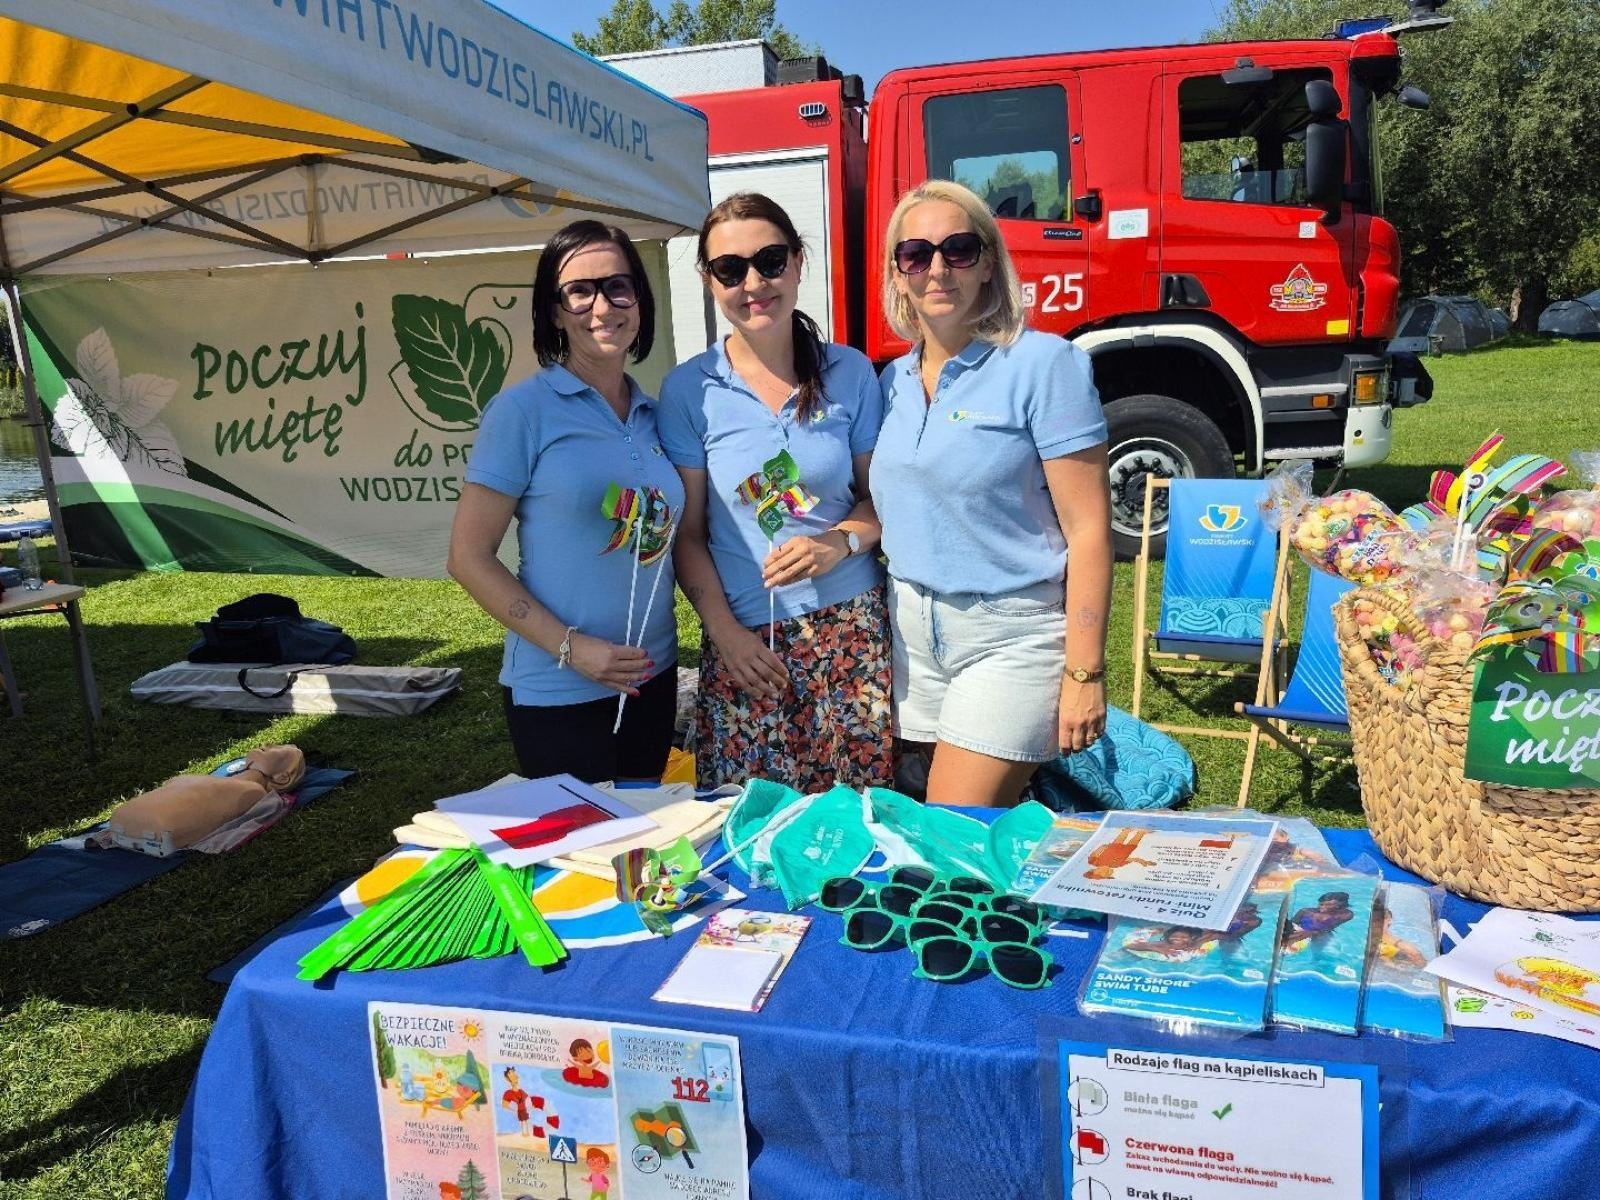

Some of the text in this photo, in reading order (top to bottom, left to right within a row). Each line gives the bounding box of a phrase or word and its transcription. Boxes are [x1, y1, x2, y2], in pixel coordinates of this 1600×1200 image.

[272, 0, 654, 162] IATWODZISLAWSKI.PL
[1041, 272, 1083, 313] 25
[191, 302, 367, 406] Poczuj
[215, 396, 343, 463] miętę
[394, 429, 433, 467] do
[340, 476, 464, 501] WODZIS
[1056, 884, 1125, 900] ratownika
[1171, 907, 1206, 919] Quiz
[1095, 981, 1168, 994] SWIM TUBE
[1096, 973, 1192, 987] SANDY SHORE
[380, 1015, 455, 1033] BEZPIECZNE
[386, 1033, 447, 1049] WAKACJE!
[1113, 1053, 1318, 1081] Rodzaje flag na kąpieliskach
[671, 1076, 711, 1102] 112
[1124, 1091, 1198, 1110] Biała flaga
[1125, 1137, 1234, 1162] Czerwona flaga
[1125, 1152, 1150, 1161] Zakaz
[1152, 1156, 1203, 1169] wchodzenia
[1204, 1161, 1215, 1169] do
[1217, 1164, 1242, 1174] wody.
[1244, 1167, 1260, 1175] Nie
[1261, 1168, 1288, 1178] wolno
[1289, 1171, 1303, 1182] się
[1126, 1163, 1151, 1172] nawet
[1165, 1167, 1195, 1179] własną
[1197, 1172, 1278, 1188] odpowiedzialność!
[1127, 1187, 1159, 1200] Brak
